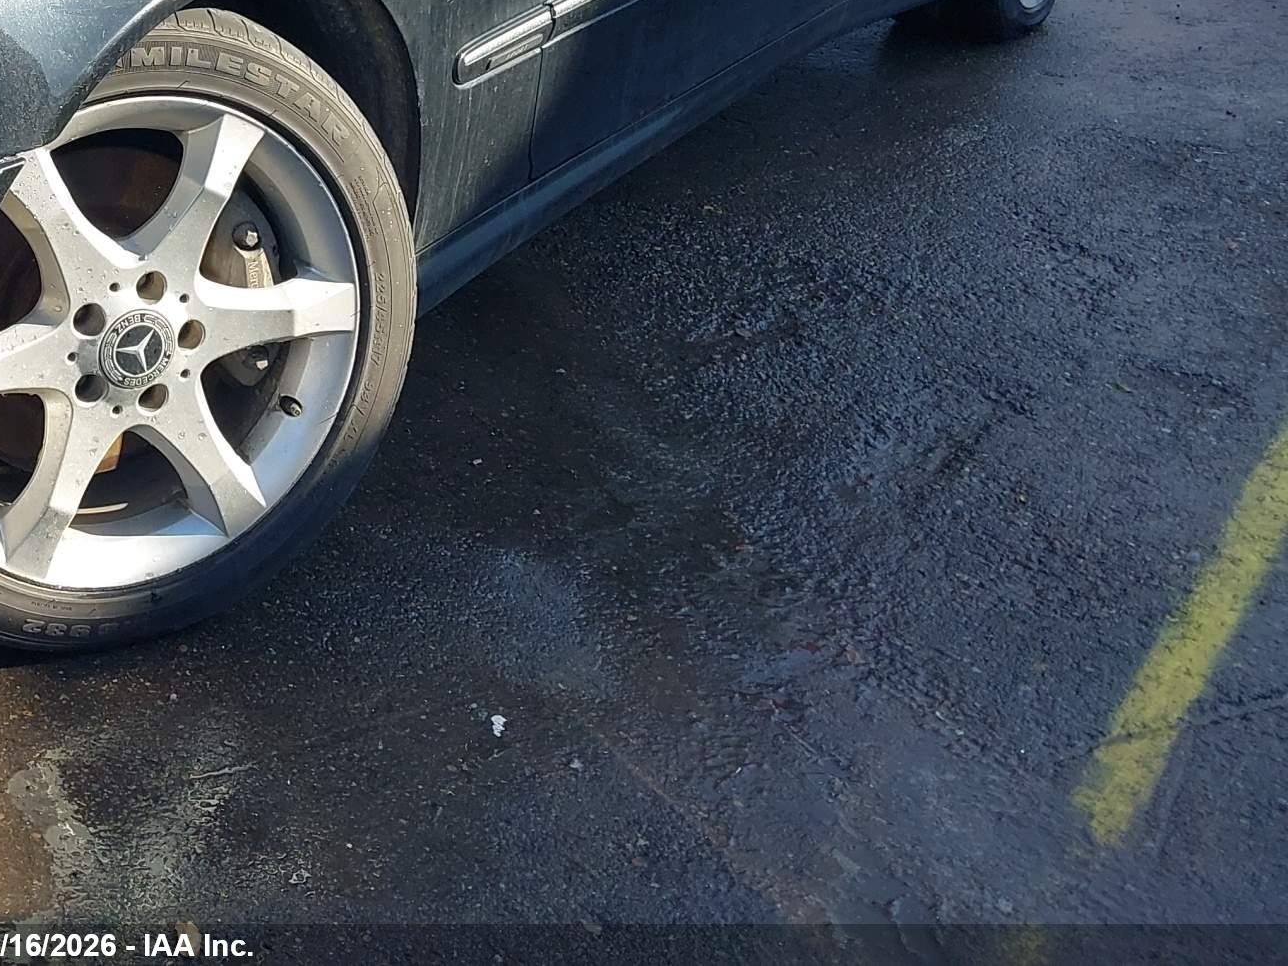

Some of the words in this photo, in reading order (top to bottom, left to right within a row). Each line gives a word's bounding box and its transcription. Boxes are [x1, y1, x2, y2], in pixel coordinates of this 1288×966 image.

[130, 46, 350, 146] MILESTAR
[114, 314, 141, 334] BENZ
[123, 356, 170, 386] MERCEDES
